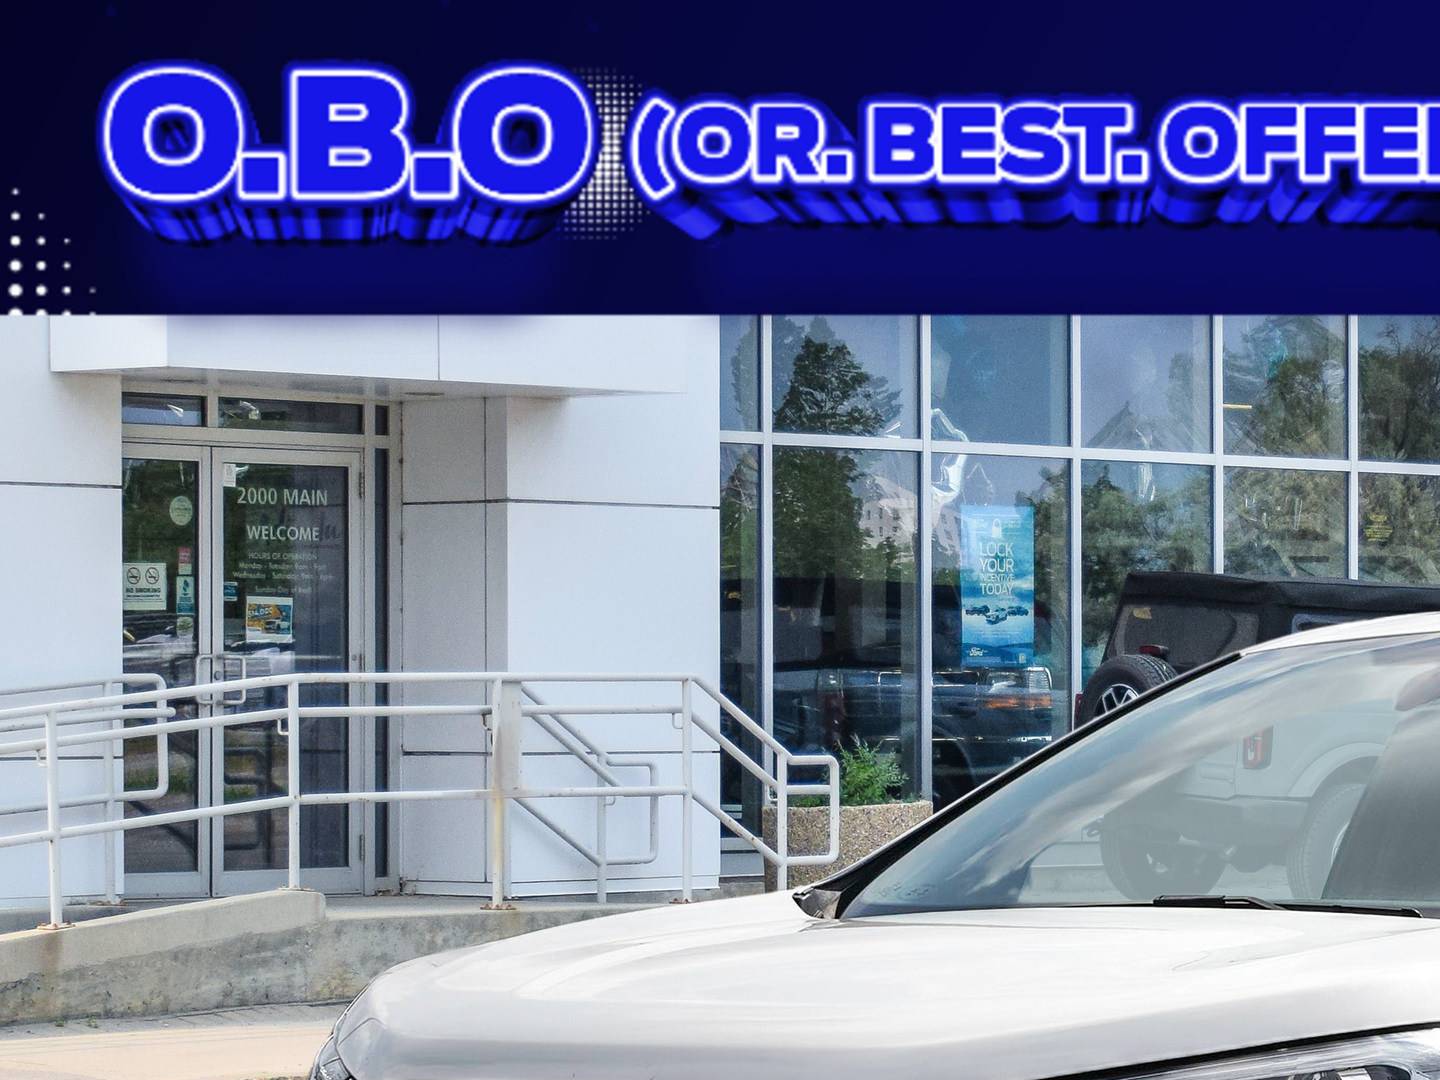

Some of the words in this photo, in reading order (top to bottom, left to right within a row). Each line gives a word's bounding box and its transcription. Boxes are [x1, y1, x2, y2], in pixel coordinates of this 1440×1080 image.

[237, 487, 278, 505] 2000
[283, 488, 328, 506] MAIN
[246, 525, 320, 541] WELCOME
[979, 541, 1014, 557] LOCK
[979, 558, 1015, 573] YOUR
[980, 573, 1014, 582] INCENTIVE
[980, 583, 1014, 596] TODAY
